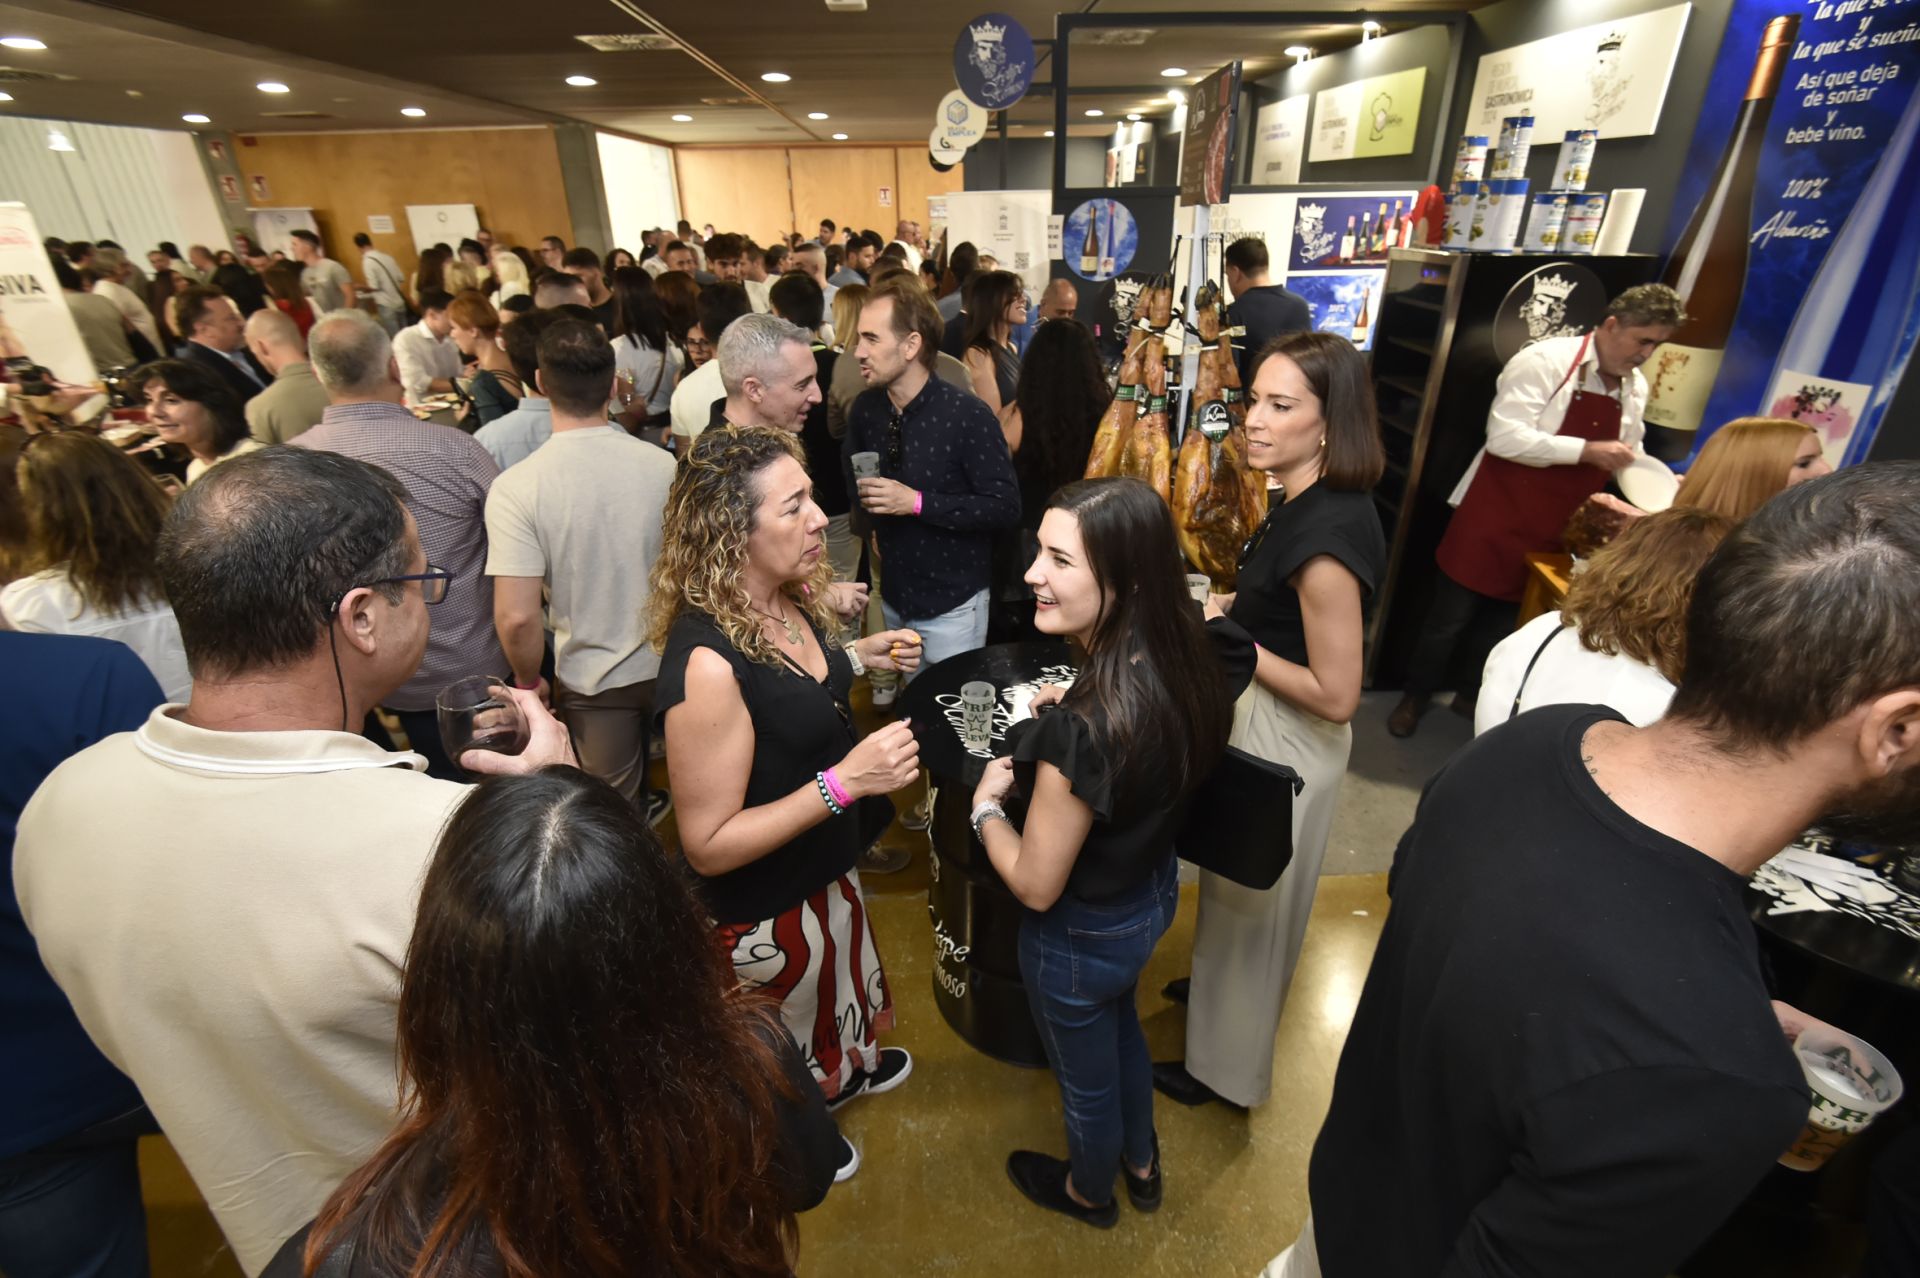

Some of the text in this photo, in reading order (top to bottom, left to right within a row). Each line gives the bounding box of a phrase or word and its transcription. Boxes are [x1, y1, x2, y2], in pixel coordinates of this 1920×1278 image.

[1814, 0, 1834, 20] la
[1834, 0, 1868, 21] que
[1855, 16, 1873, 37] y
[1793, 41, 1812, 60] la
[1812, 39, 1845, 62] que
[1845, 36, 1868, 51] se
[1795, 63, 1900, 90] Así que deja
[1802, 85, 1878, 108] de soñar
[1824, 109, 1838, 127] y
[1785, 123, 1867, 144] bebe vino.
[1782, 177, 1829, 199] 100%
